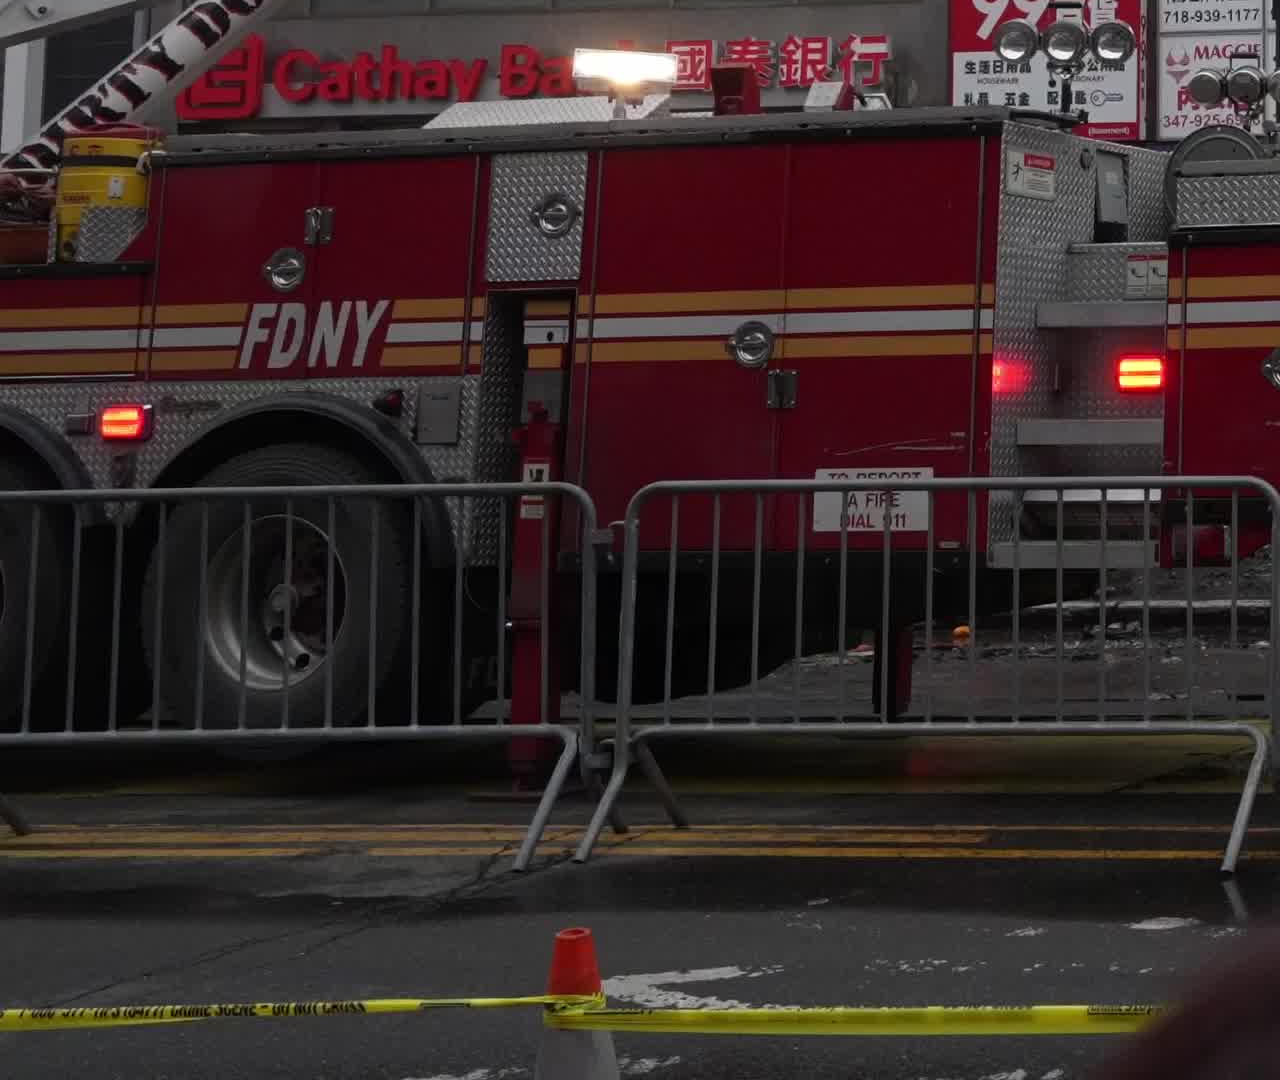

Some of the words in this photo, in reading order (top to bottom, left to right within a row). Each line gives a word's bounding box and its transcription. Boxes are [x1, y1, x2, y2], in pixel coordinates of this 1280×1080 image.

[1163, 8, 1260, 24] 718-939-1177
[273, 40, 488, 104] Cathay
[1004, 92, 1030, 106] 五金
[1047, 91, 1087, 105] 配匙
[239, 300, 392, 370] FDNY
[848, 493, 858, 508] A
[866, 492, 900, 508] FIRE
[840, 514, 875, 528] DIAL
